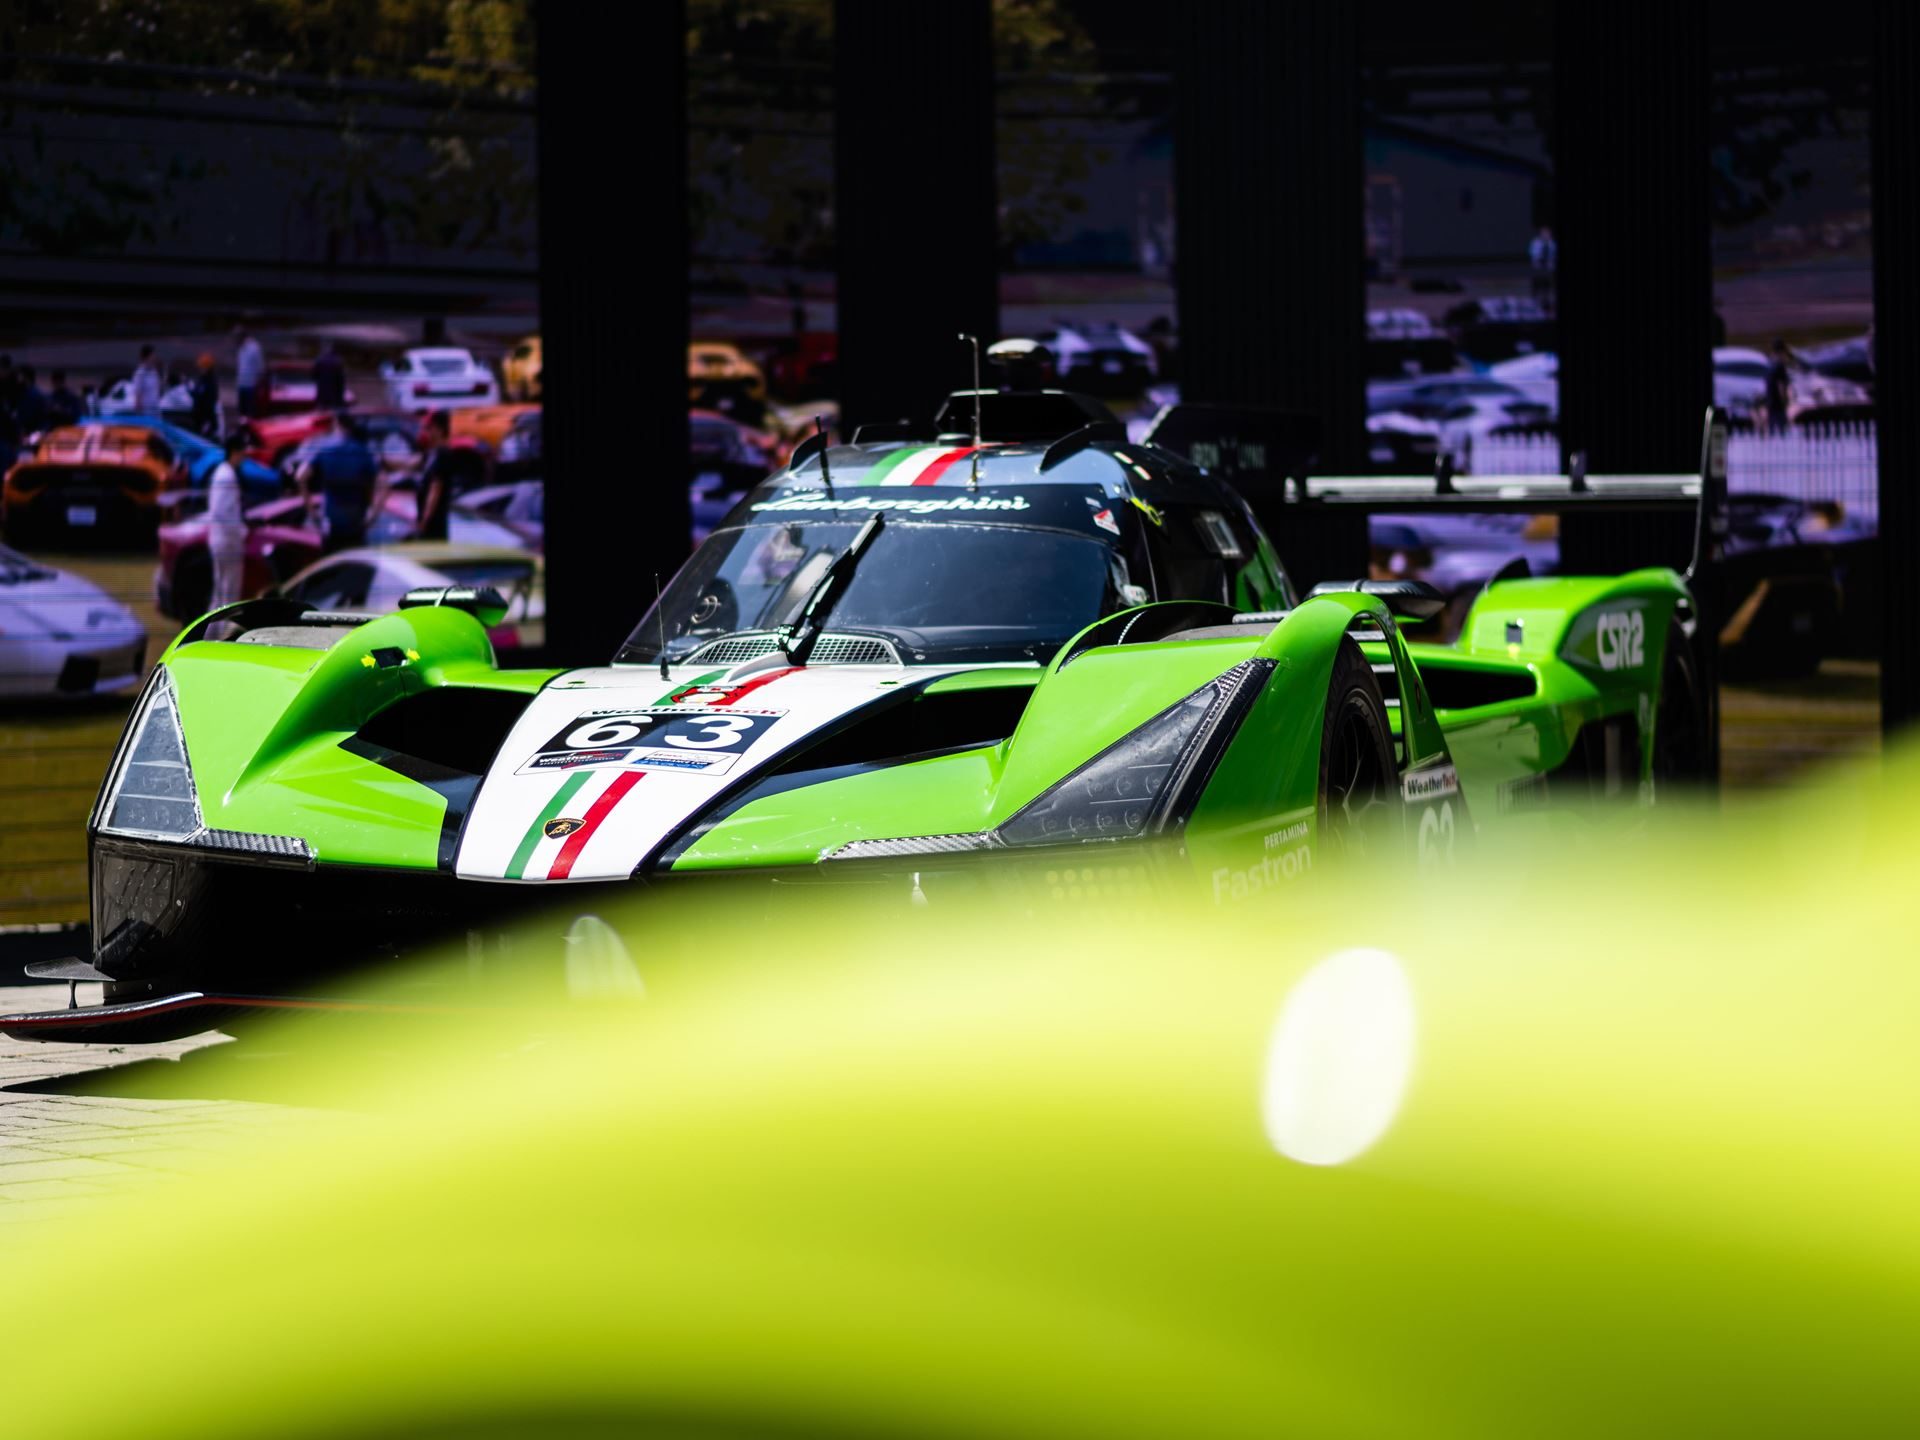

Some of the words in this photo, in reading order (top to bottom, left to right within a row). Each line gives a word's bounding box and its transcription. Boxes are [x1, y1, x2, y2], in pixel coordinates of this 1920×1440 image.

[750, 492, 1031, 515] Lamborghini
[1597, 609, 1644, 671] CSR2
[592, 706, 779, 716] WeatherTech
[565, 714, 755, 749] 63
[1407, 772, 1456, 796] WeatherTech
[1264, 820, 1308, 850] PERTAMINA
[1212, 844, 1312, 906] Fastron
